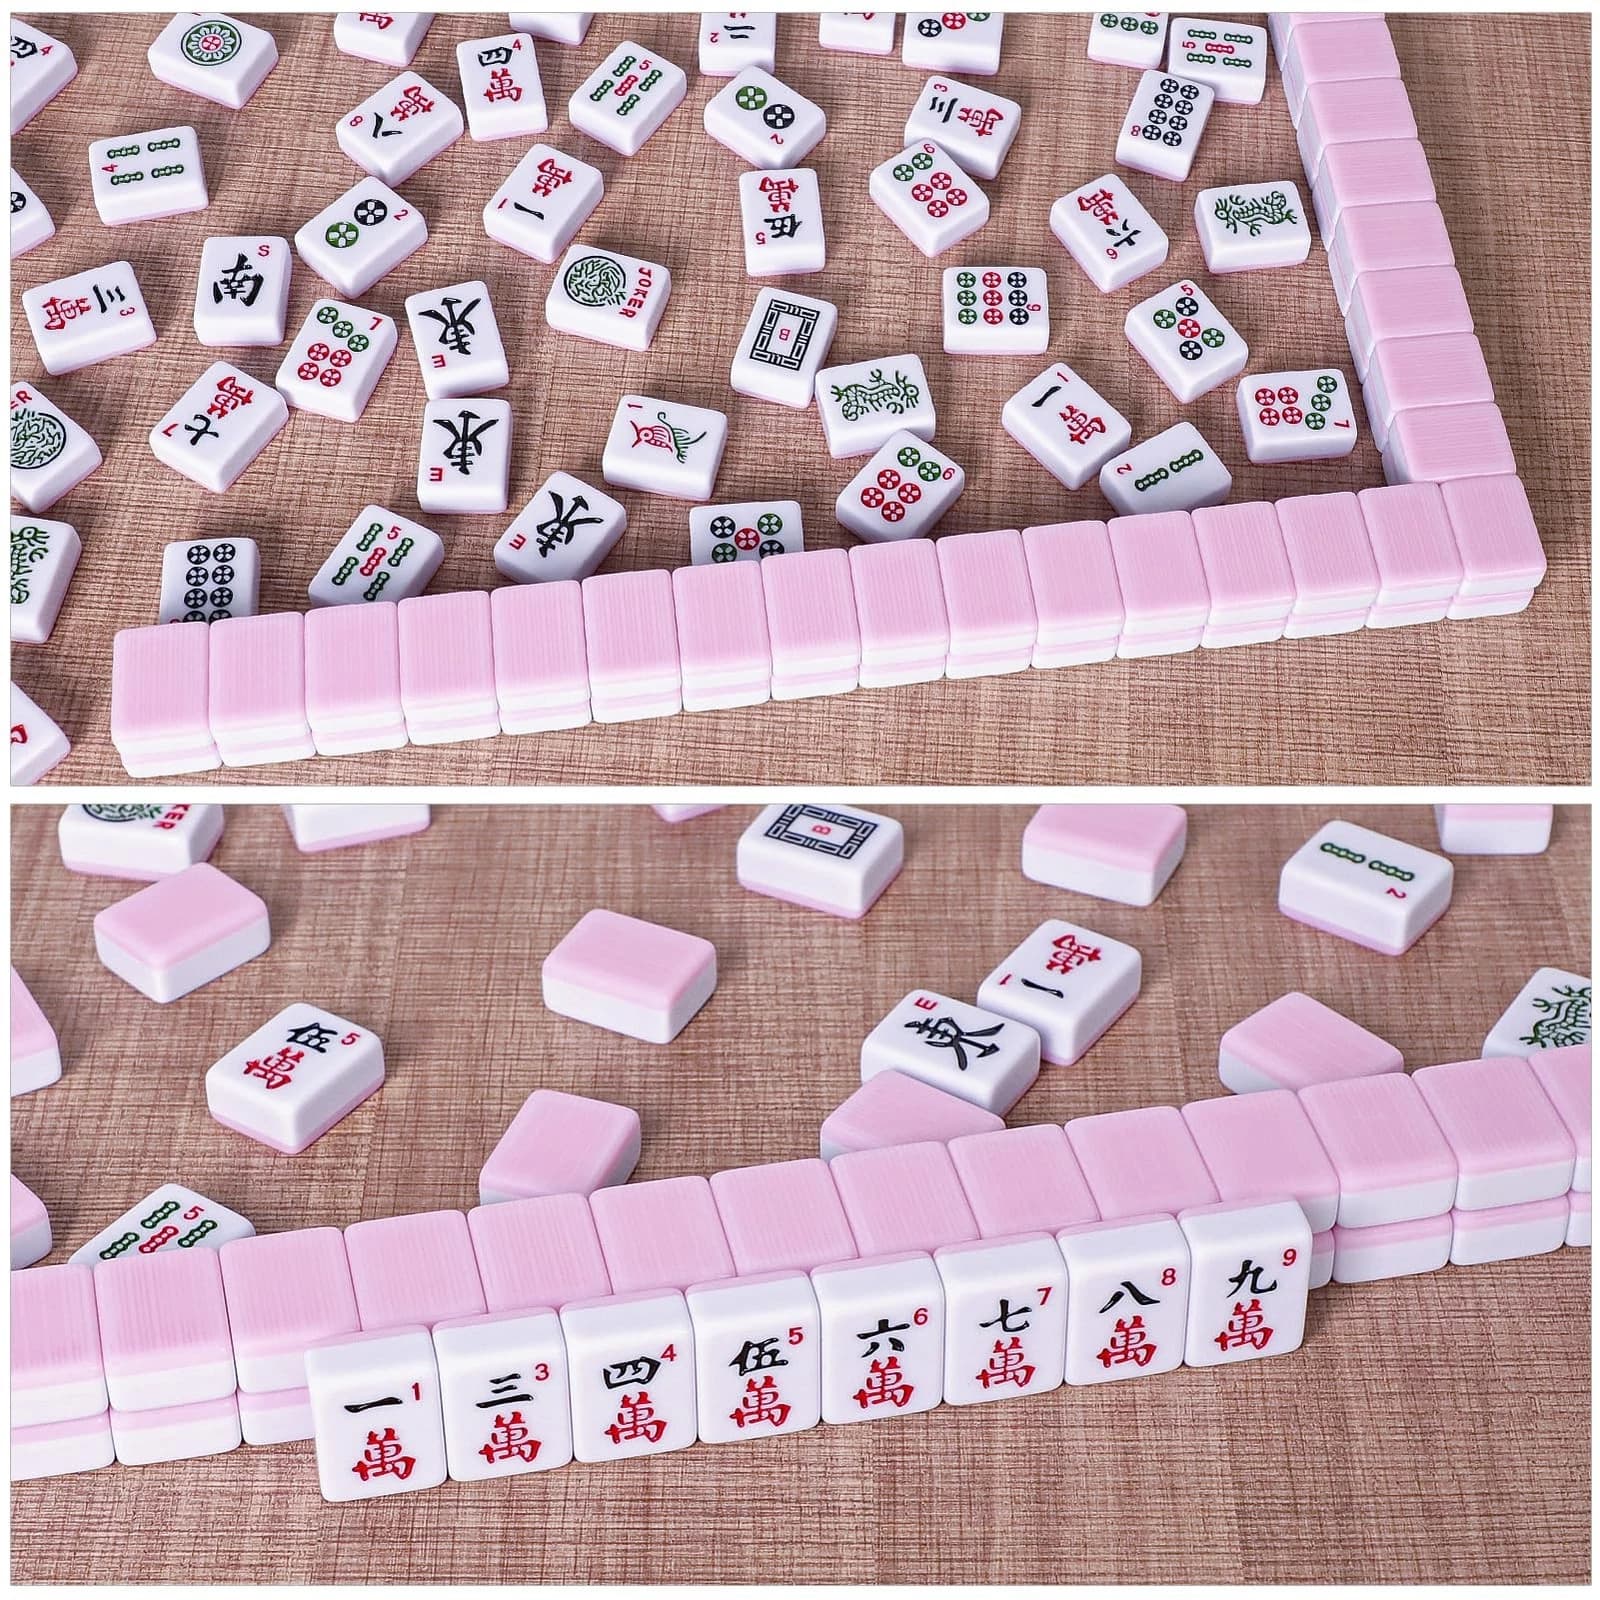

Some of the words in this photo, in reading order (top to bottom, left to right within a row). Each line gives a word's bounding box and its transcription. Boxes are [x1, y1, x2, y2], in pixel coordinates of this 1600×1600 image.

[512, 38, 523, 50] 4
[709, 31, 720, 44] 2
[40, 44, 54, 56] 4
[1182, 41, 1197, 50] 5
[638, 59, 652, 71] 5
[933, 83, 949, 93] 3
[349, 115, 364, 127] 8
[1130, 124, 1143, 137] 8
[770, 133, 784, 145] 2
[922, 143, 936, 154] 6
[101, 163, 118, 173] 4
[497, 197, 508, 209] 1
[393, 208, 409, 221] 2
[755, 231, 766, 245] 5
[258, 244, 270, 257] S
[1105, 247, 1119, 260] 6
[213, 254, 264, 306] 南
[620, 267, 652, 318] JOKER
[1180, 283, 1194, 297] 5
[119, 307, 136, 317] 3
[1027, 303, 1042, 312] 9
[370, 316, 384, 331] 7
[419, 298, 481, 355] 東
[779, 328, 791, 342] B
[432, 353, 447, 369] E
[1056, 371, 1069, 383] 1
[162, 423, 178, 438] 7
[1333, 420, 1350, 429] 7
[431, 411, 498, 476] 東
[430, 466, 444, 483] E
[942, 467, 956, 481] 6
[1116, 463, 1133, 475] 2
[534, 489, 604, 558] 東
[386, 525, 401, 541] 5
[509, 533, 527, 551] E
[811, 824, 832, 836] B
[1385, 887, 1408, 900] 2
[998, 973, 1013, 986] 1
[913, 996, 939, 1011] E
[340, 1032, 361, 1046] 5
[904, 1018, 1004, 1070] 東
[183, 1205, 205, 1221] 5
[1281, 1248, 1298, 1267] 9
[1160, 1267, 1177, 1287] 8
[1037, 1286, 1054, 1305] 7
[913, 1307, 929, 1327] 6
[788, 1326, 804, 1346] 5
[659, 1343, 678, 1362] 4
[534, 1362, 550, 1382] 3
[411, 1381, 421, 1402] 1
